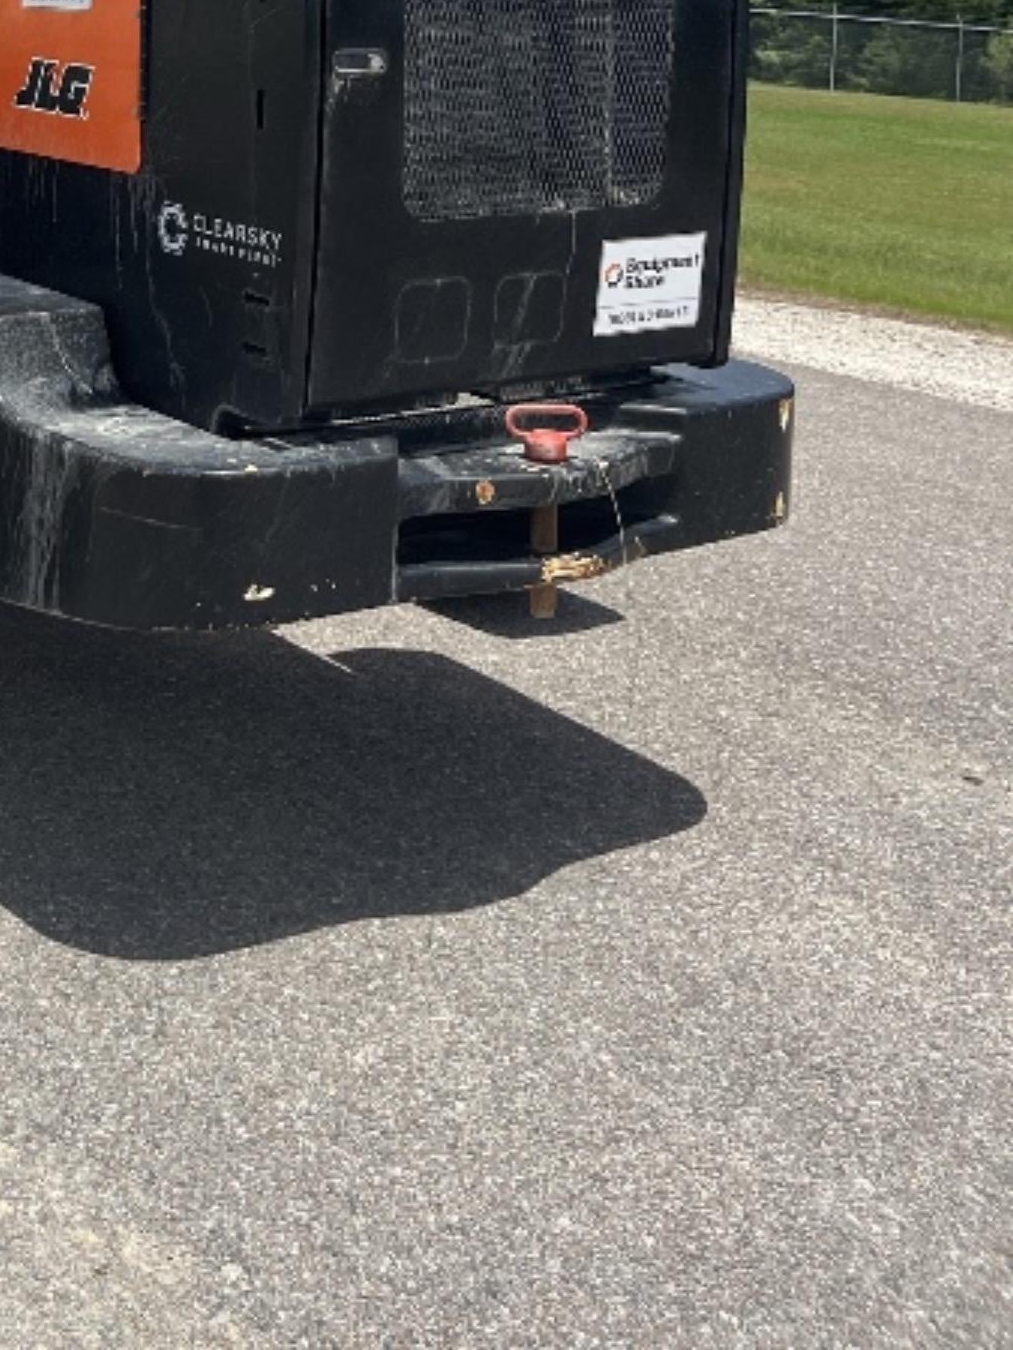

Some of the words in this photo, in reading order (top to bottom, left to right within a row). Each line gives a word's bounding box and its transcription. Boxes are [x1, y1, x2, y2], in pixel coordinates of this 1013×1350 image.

[13, 56, 96, 120] JLG
[193, 214, 282, 251] CLEARSKY
[625, 253, 700, 274] Equipment
